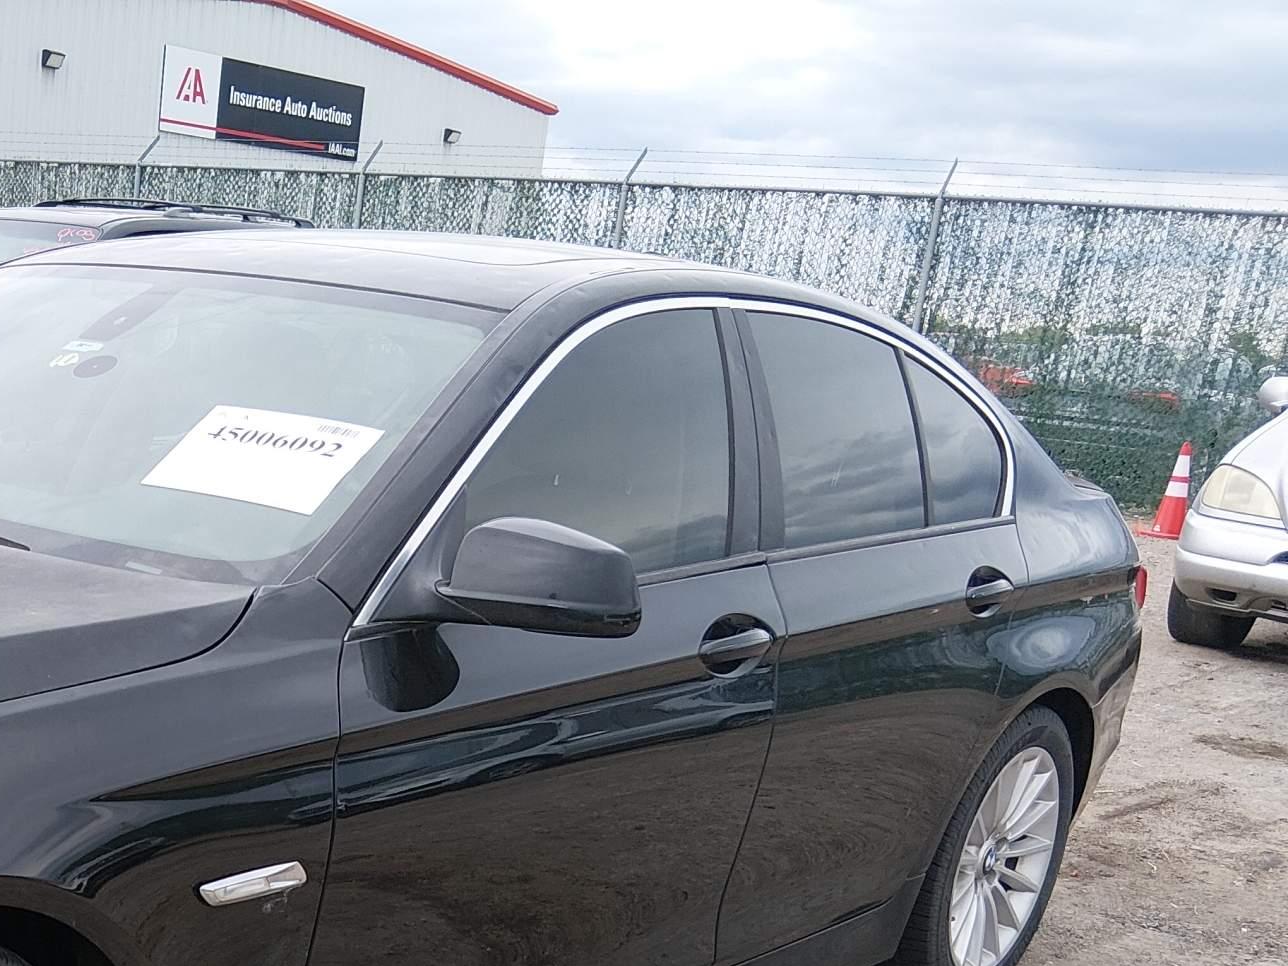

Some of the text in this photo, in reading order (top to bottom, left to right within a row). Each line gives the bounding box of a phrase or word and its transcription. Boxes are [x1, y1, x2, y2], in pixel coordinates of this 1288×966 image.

[229, 85, 353, 127] Insurance Auto Auctions
[208, 426, 343, 457] 45006092
